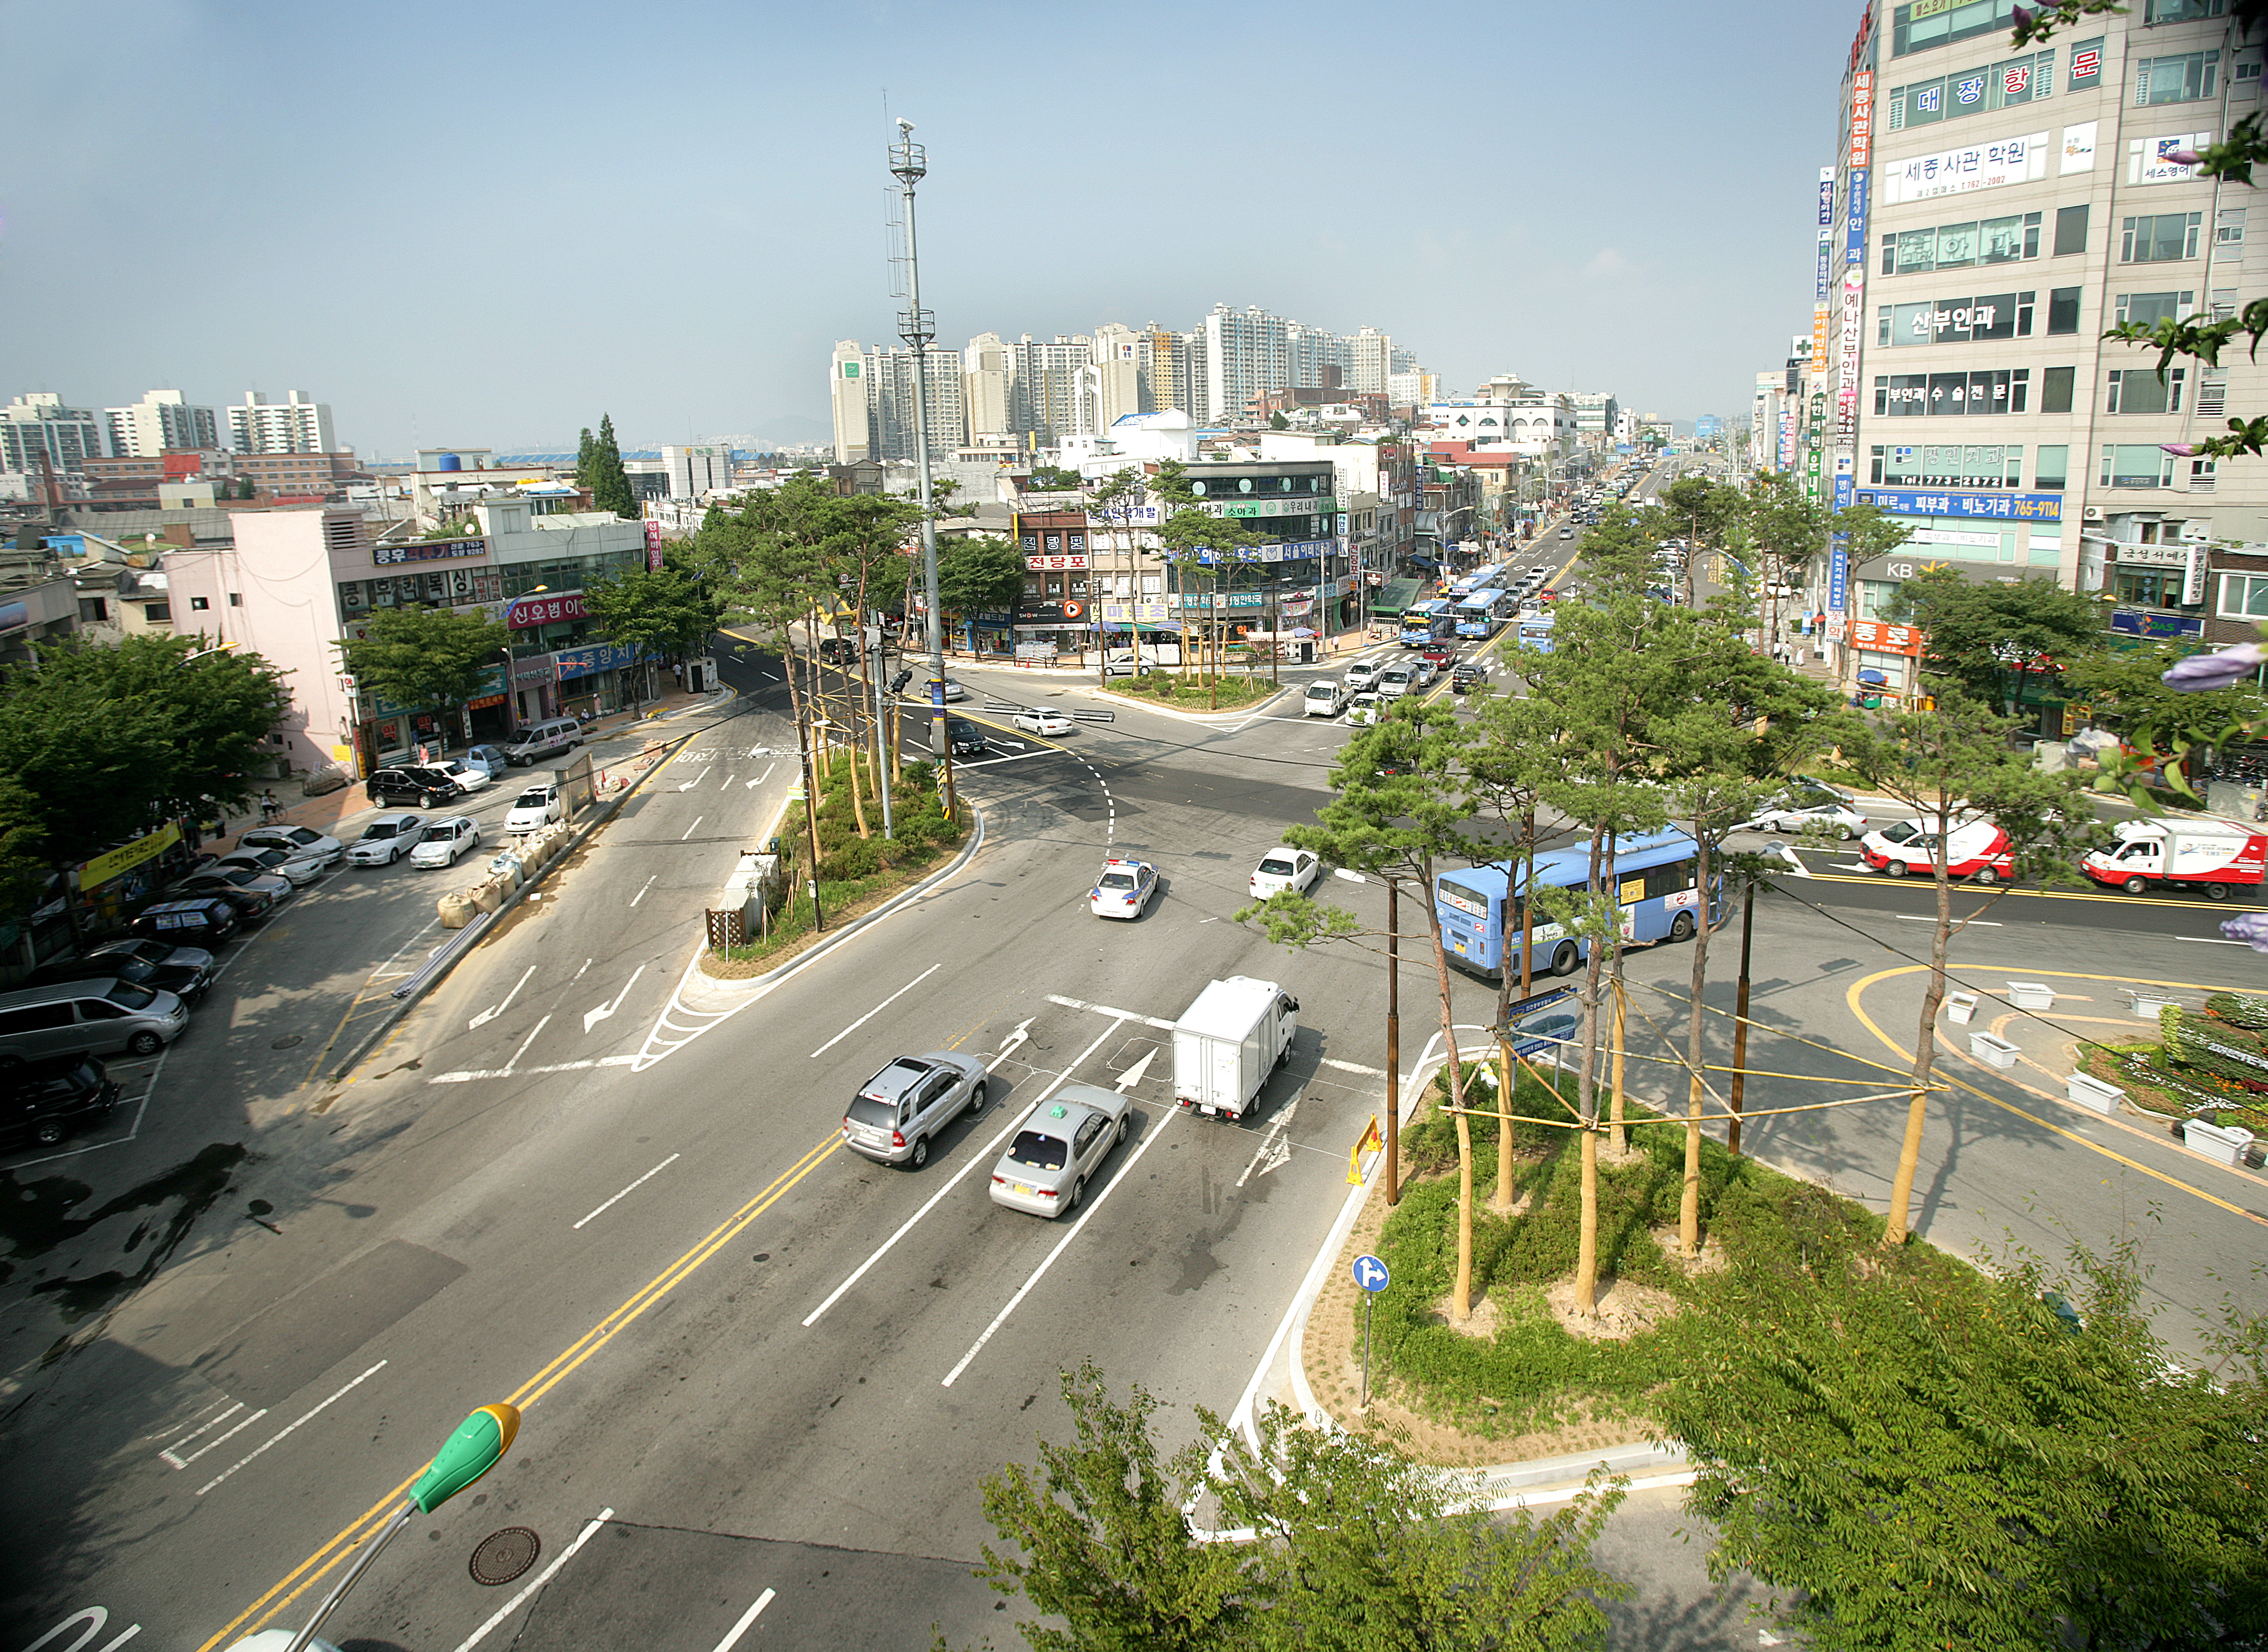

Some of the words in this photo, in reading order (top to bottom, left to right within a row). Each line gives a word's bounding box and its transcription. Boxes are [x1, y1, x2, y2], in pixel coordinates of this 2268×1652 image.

[1850, 74, 1870, 167] 세종사관학원
[2145, 166, 2188, 178] 세스영어
[1912, 305, 1996, 335] 산부인과
[1841, 293, 1859, 392] 예나산부인과
[1890, 387, 1926, 403] 부인과
[1810, 405, 1822, 447] 한의원
[1926, 476, 2000, 486] 773-2872
[1228, 507, 1257, 516] 소아과
[1915, 496, 1950, 514] 피부과
[1962, 498, 2011, 516] 비뇨기과
[2013, 500, 2060, 517] 765-9114
[647, 523, 660, 571] 신이비인후
[1023, 535, 1083, 551] 전당포
[1029, 556, 1086, 569] 전당포
[1350, 544, 1358, 574] 전당포
[1887, 562, 1913, 578] KB
[1854, 623, 1910, 645] 종로
[417, 716, 431, 731] 약
[382, 724, 396, 740] 약
[1456, 898, 1467, 908] 2
[1475, 924, 1484, 932] 2
